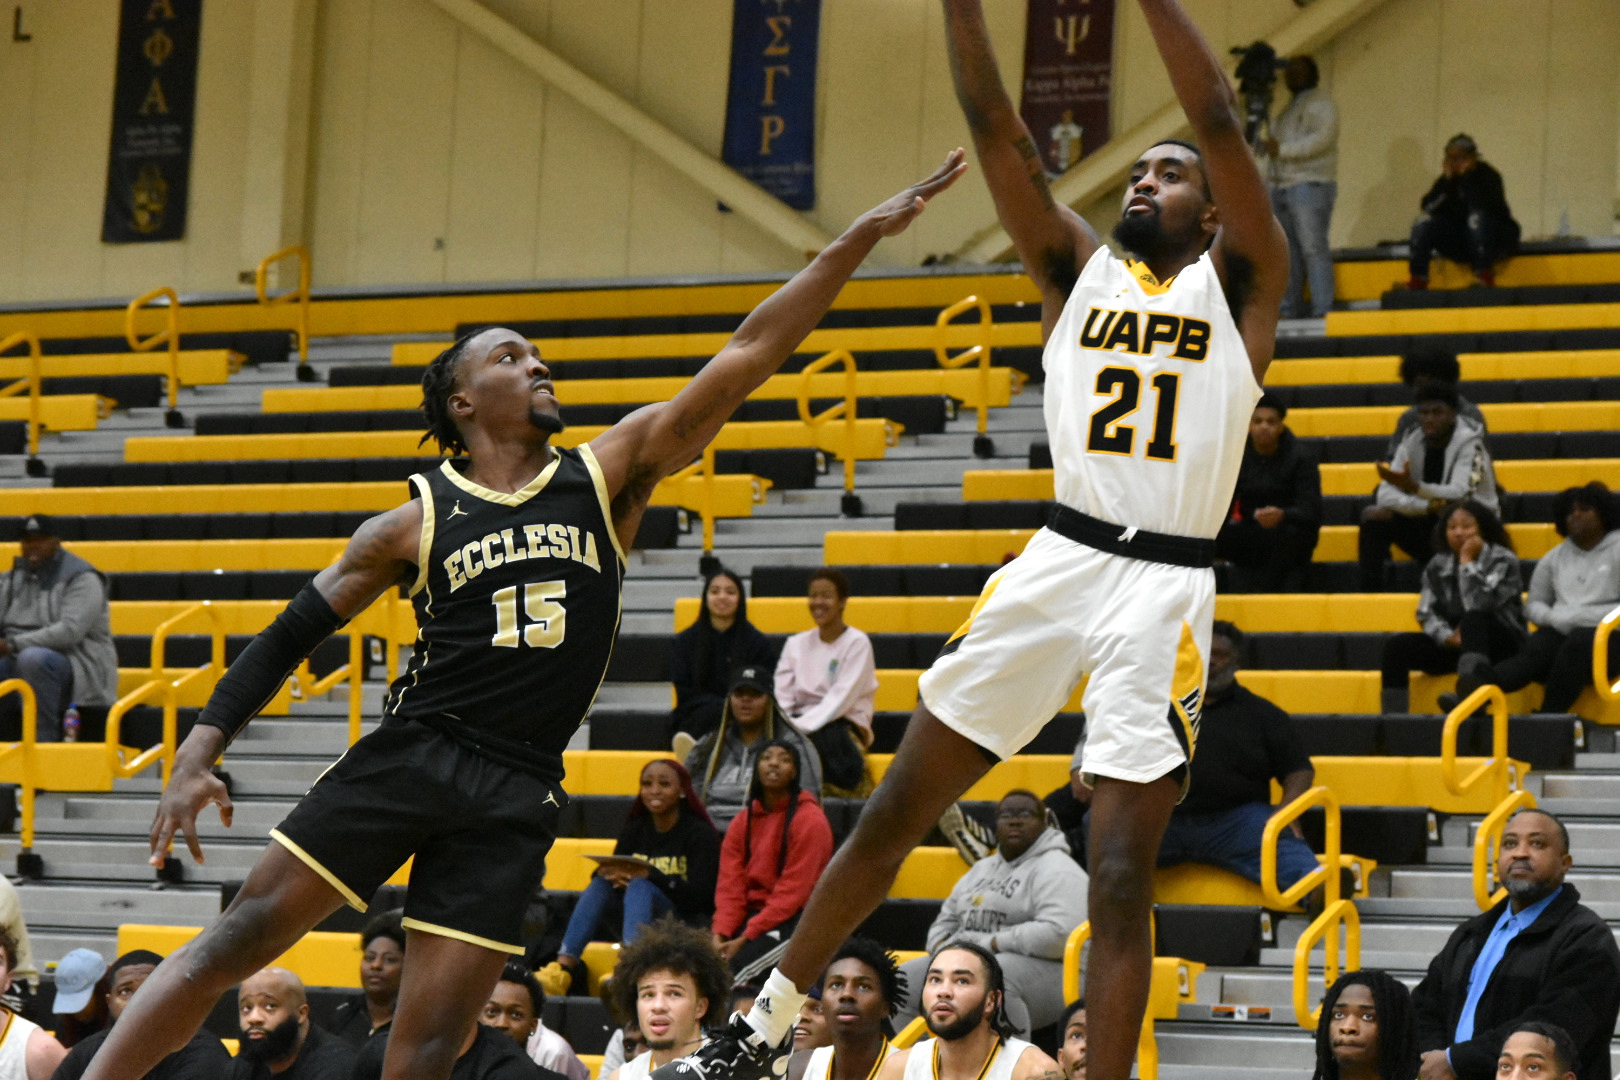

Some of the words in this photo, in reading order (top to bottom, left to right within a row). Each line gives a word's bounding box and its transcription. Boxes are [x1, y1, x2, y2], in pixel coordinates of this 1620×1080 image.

[1080, 306, 1212, 363] UAPB
[1086, 365, 1182, 463] 21
[443, 524, 601, 594] ECCLESIA
[491, 580, 567, 649] 15
